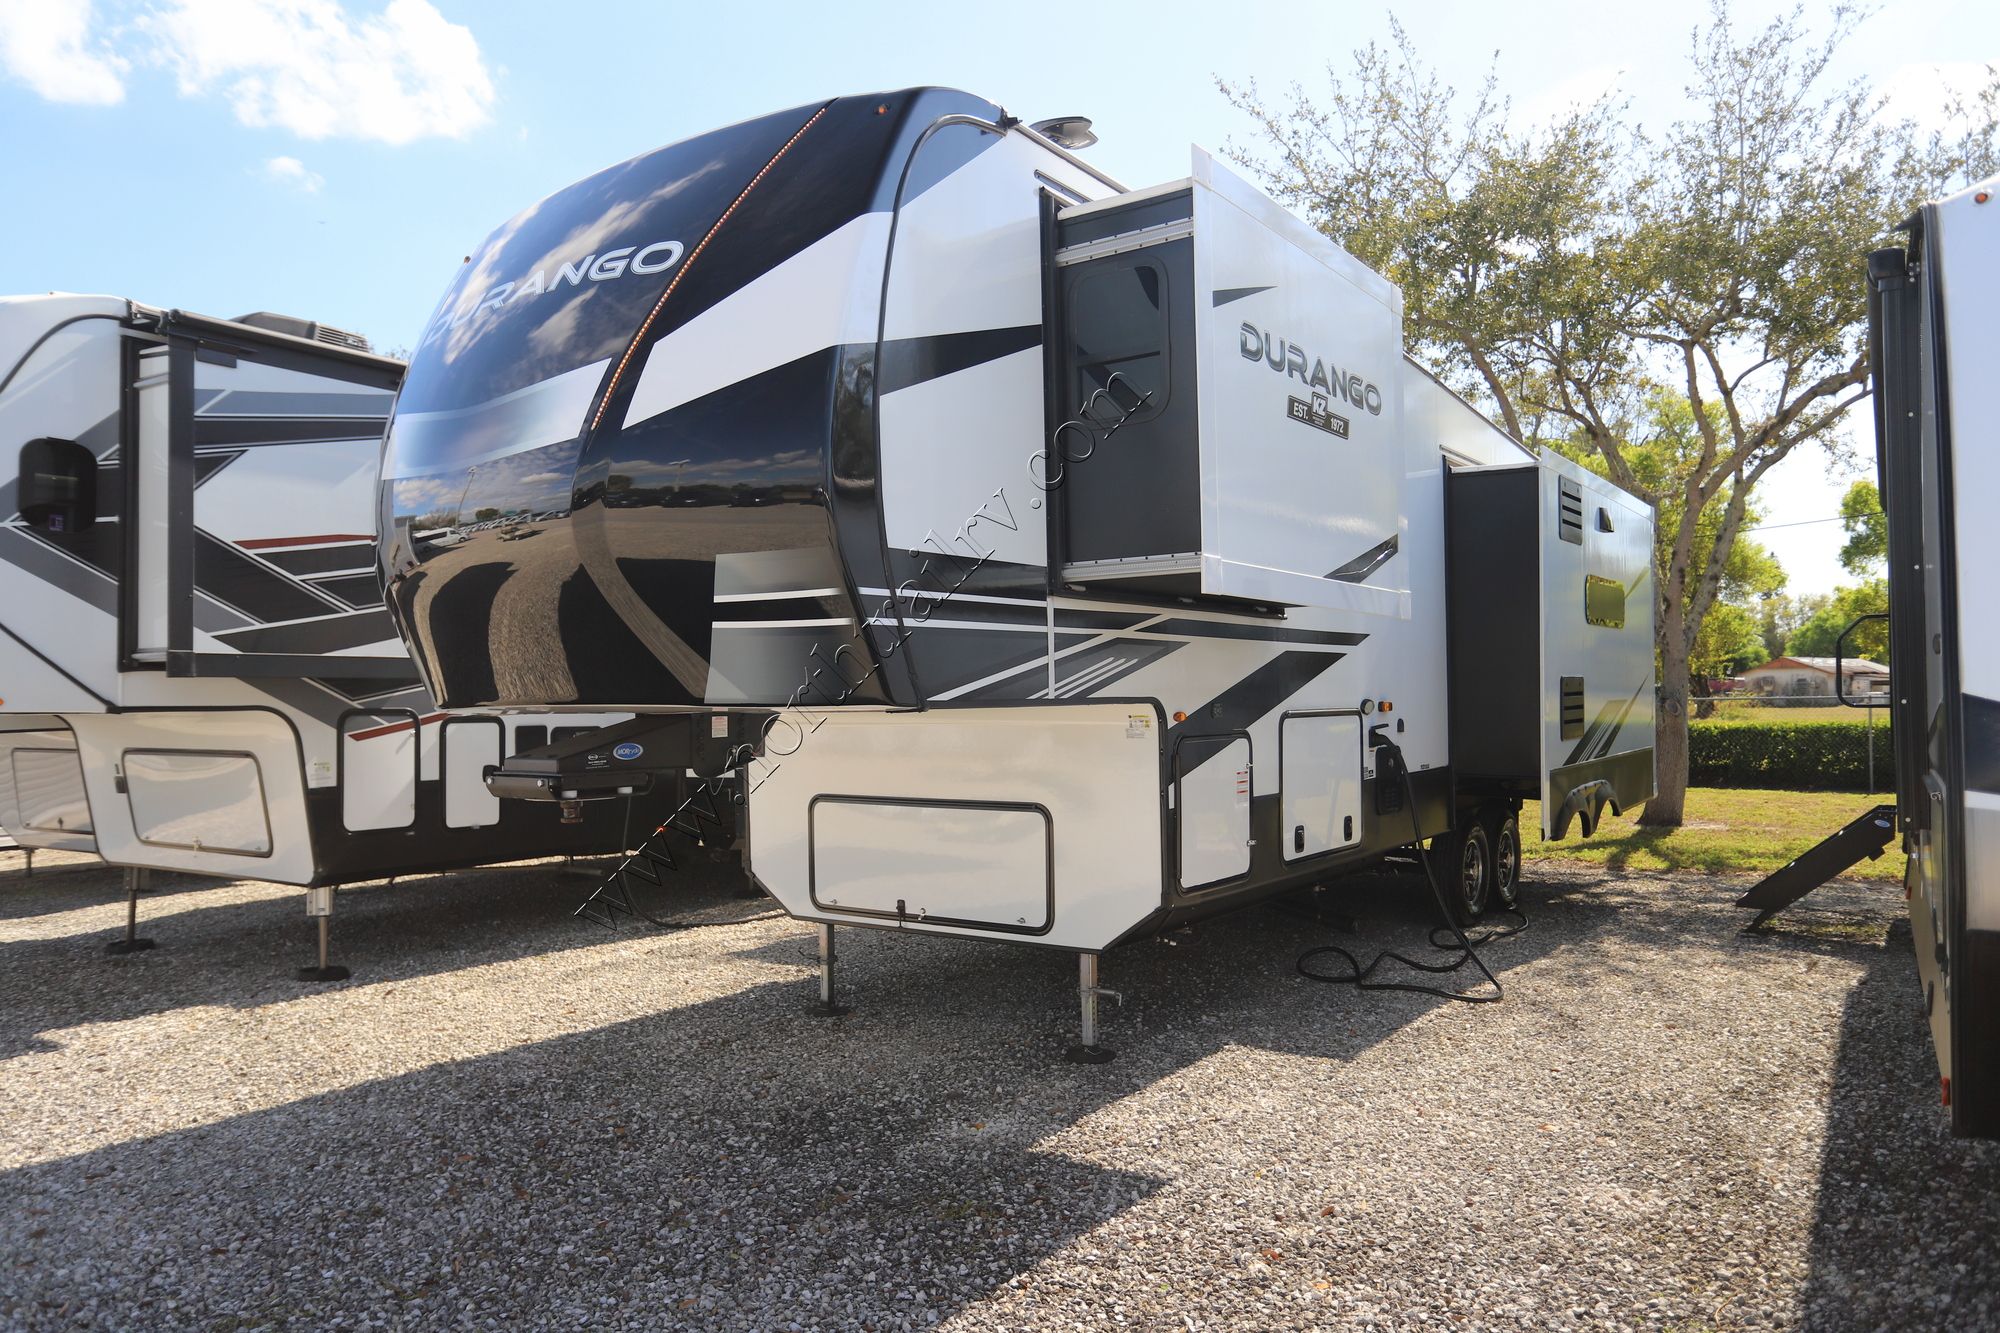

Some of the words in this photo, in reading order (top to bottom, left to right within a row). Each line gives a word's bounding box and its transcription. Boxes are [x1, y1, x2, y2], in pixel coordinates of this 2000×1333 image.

[424, 240, 685, 346] DURANGO
[1240, 321, 1382, 416] DURANGO
[1293, 402, 1309, 420] EST.
[1330, 417, 1344, 434] 1972
[1312, 396, 1327, 417] KZ
